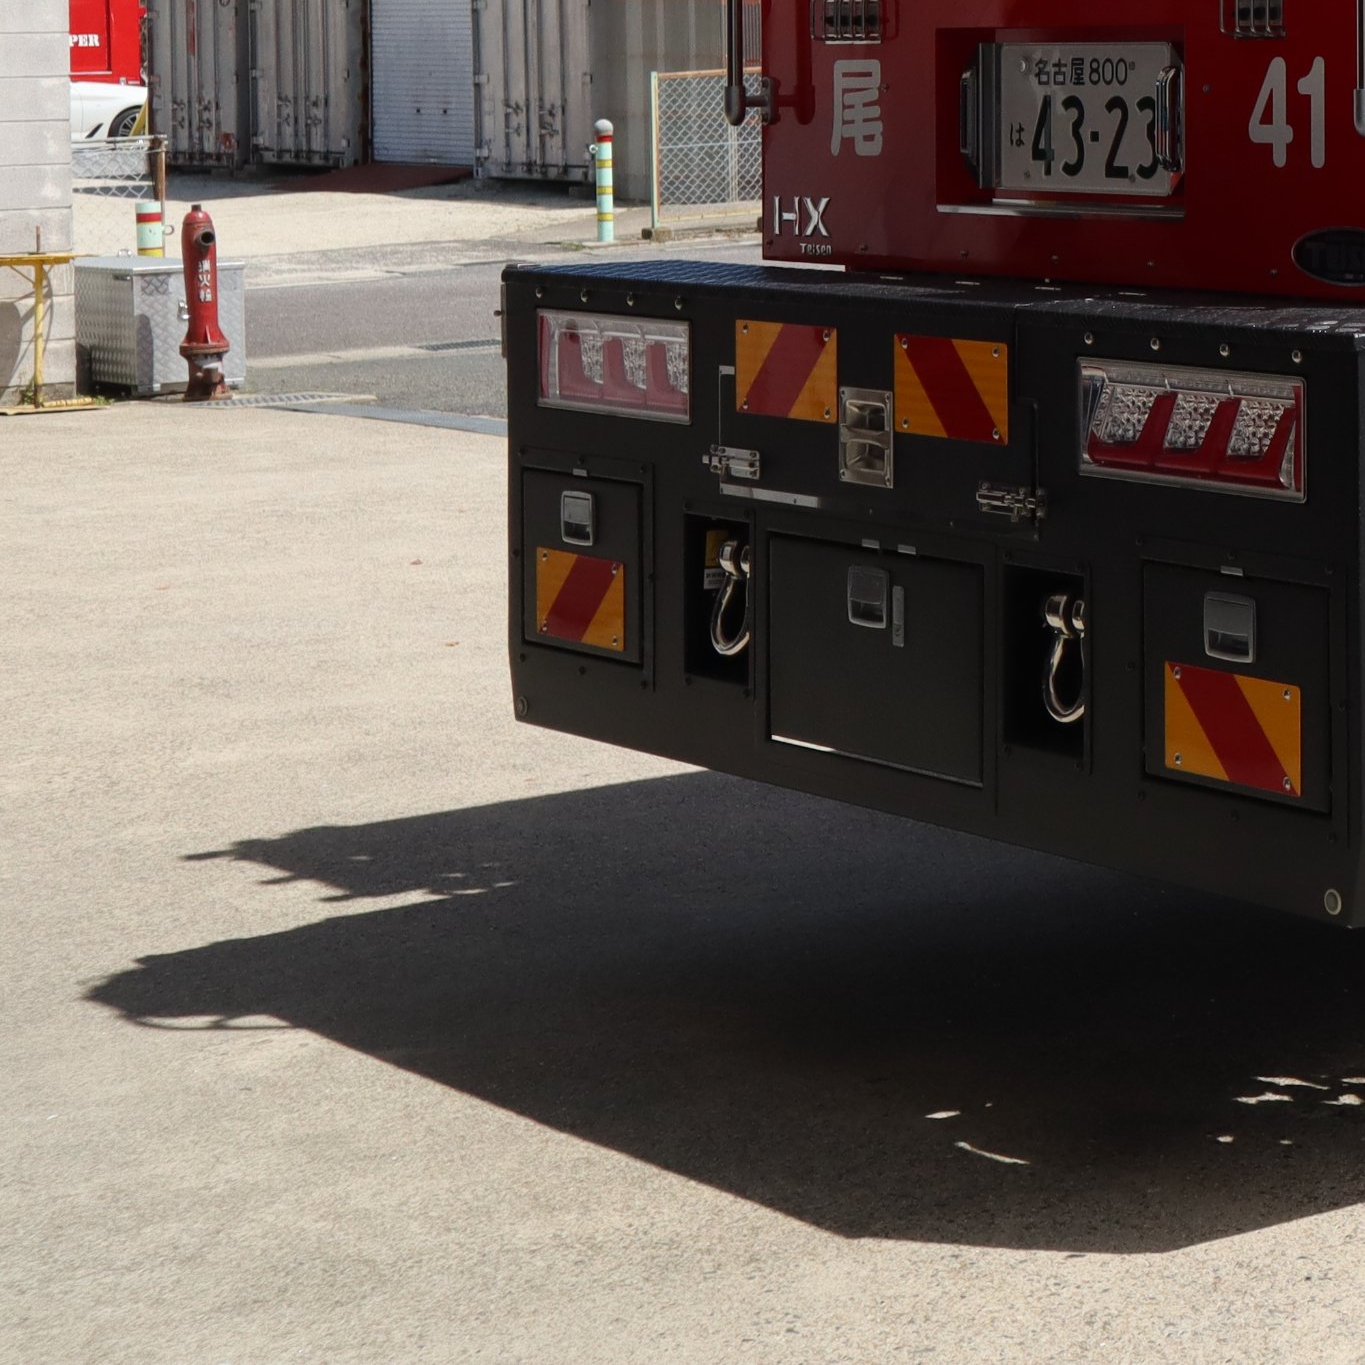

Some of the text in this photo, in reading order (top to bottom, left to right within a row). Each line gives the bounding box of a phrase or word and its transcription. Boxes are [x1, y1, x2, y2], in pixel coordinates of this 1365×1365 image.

[830, 58, 883, 156] 尾
[1010, 94, 1159, 180] は 43-23
[1248, 56, 1325, 169] 41
[773, 196, 830, 237] HX
[800, 242, 832, 255] Teisen
